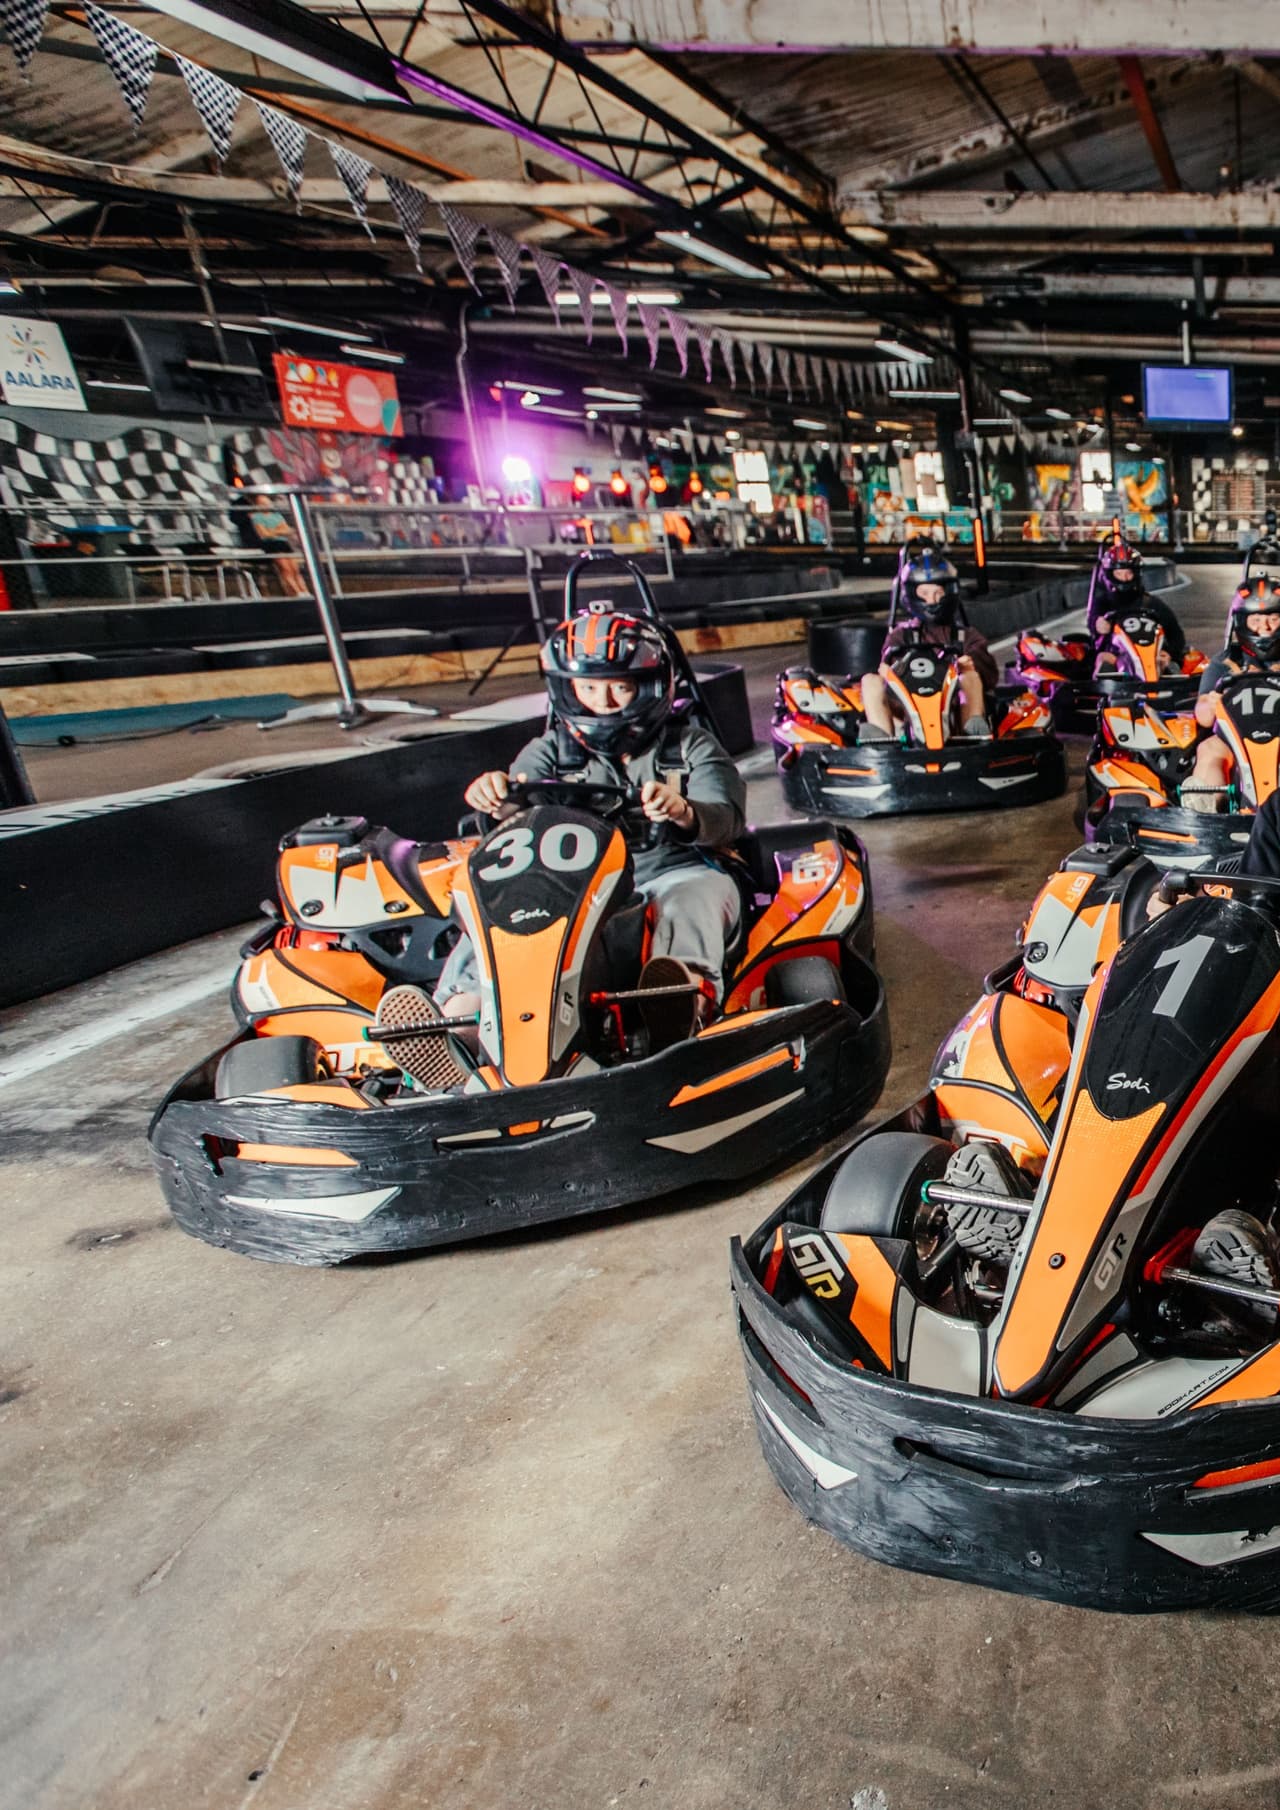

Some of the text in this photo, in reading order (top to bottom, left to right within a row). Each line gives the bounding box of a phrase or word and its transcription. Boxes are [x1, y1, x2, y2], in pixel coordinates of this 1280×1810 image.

[5, 370, 76, 391] AALARA
[1123, 617, 1157, 633] 97
[910, 657, 935, 679] 9
[478, 823, 598, 882] 30
[1153, 934, 1216, 1018] 1
[1105, 1071, 1151, 1094] Sodi
[788, 1233, 845, 1299] GTR
[1094, 1232, 1128, 1291] GTR
